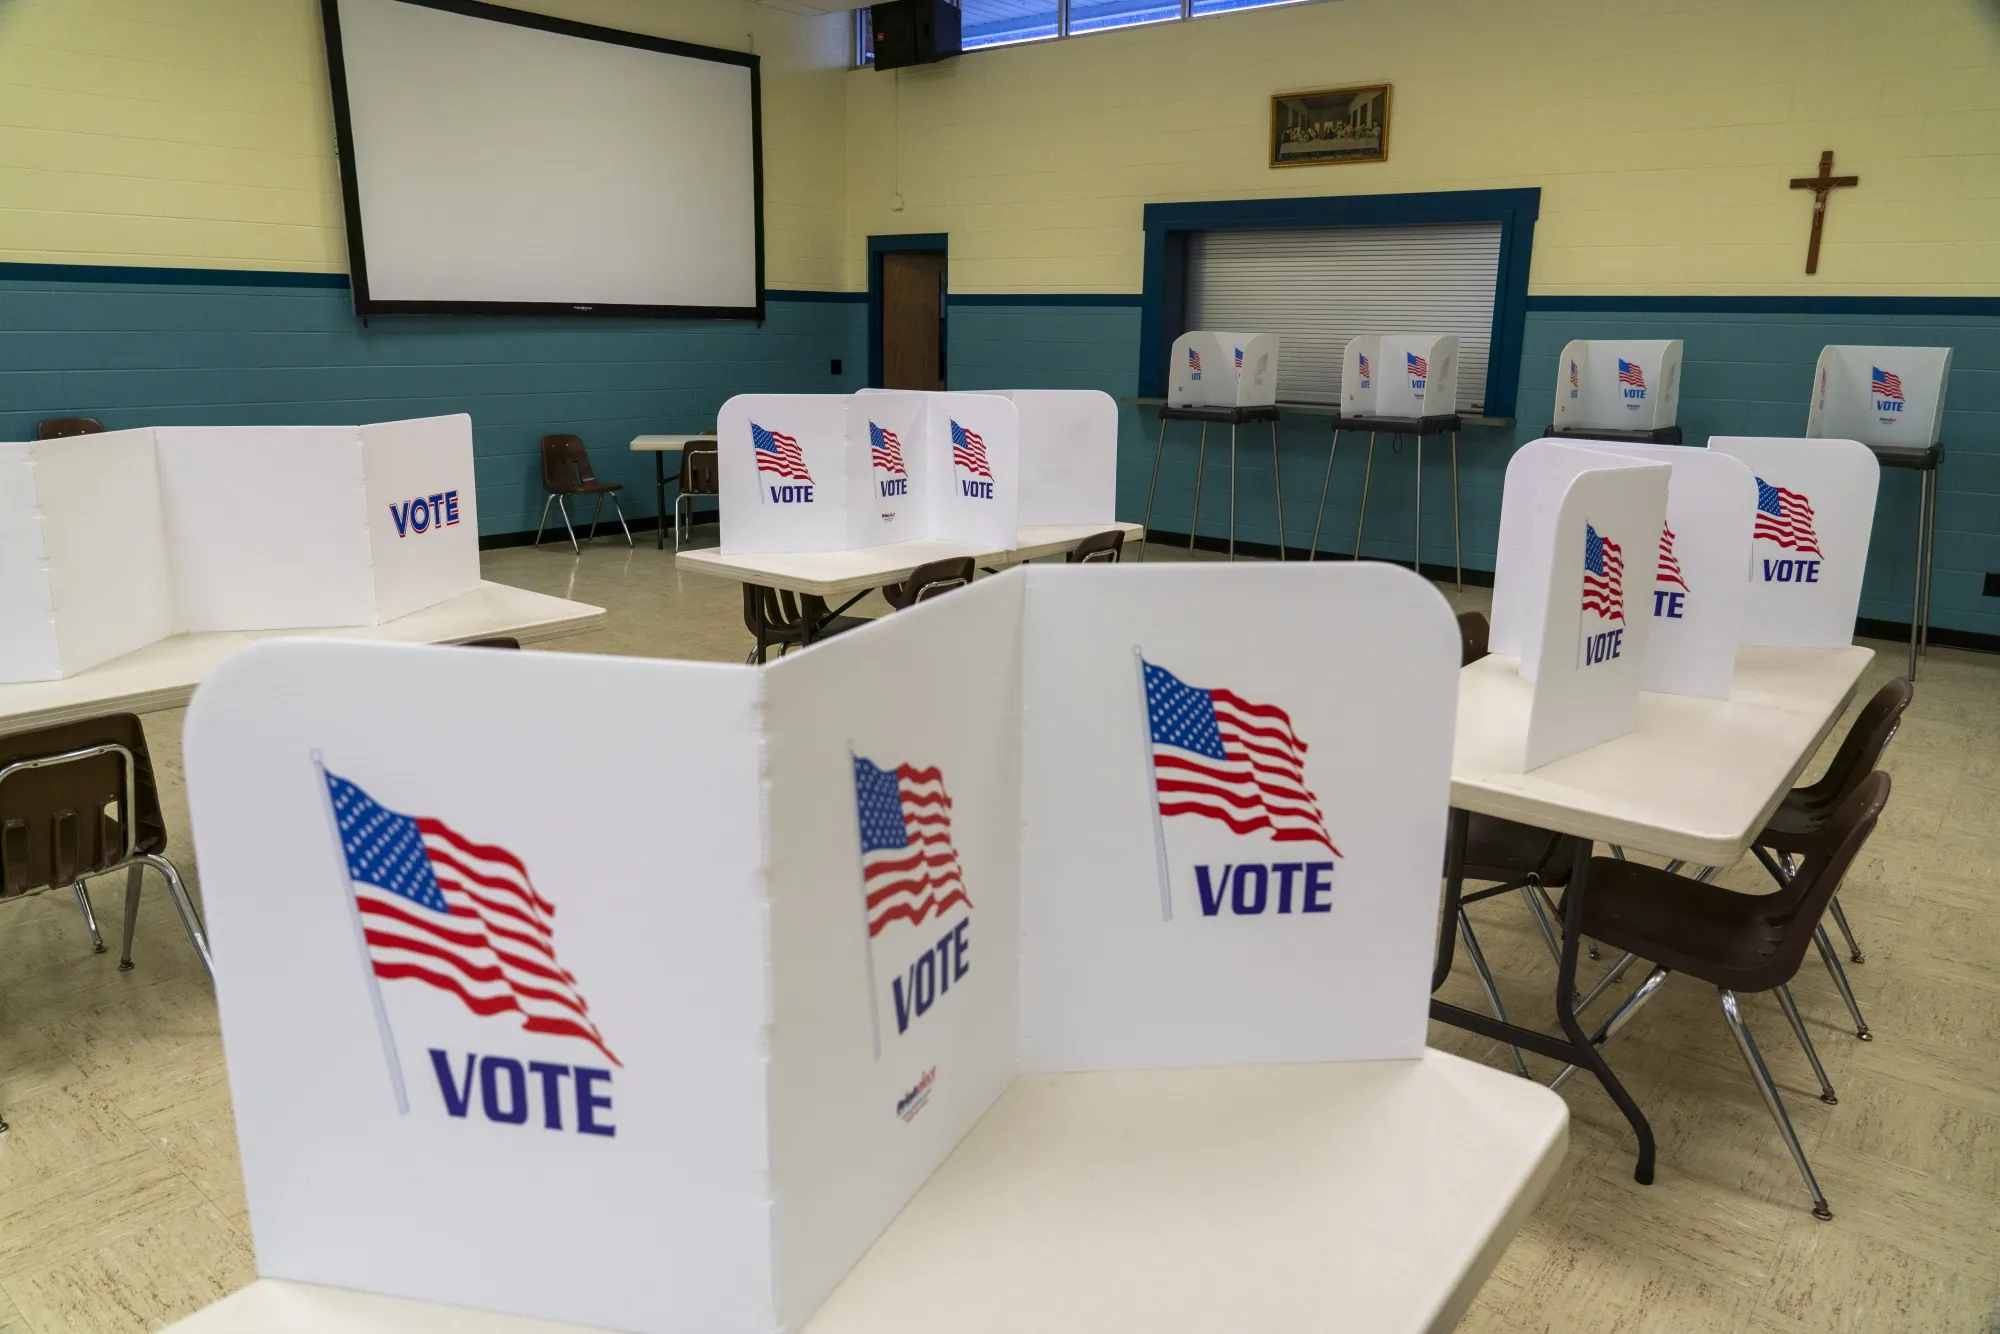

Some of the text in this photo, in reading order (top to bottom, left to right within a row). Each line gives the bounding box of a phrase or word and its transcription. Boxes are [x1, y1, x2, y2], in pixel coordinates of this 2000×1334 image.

[1412, 380, 1426, 389] VOT
[1624, 389, 1646, 399] VOTE
[1877, 400, 1904, 412] VOTE
[770, 485, 814, 504] VOTE
[880, 478, 908, 498] VOTE
[961, 479, 994, 499] VOTE
[389, 490, 460, 538] VOTE
[1762, 559, 1821, 583] VOTE
[1653, 590, 1685, 619] TE
[1586, 628, 1623, 666] VOTE
[1193, 861, 1335, 917] VOTE
[891, 916, 970, 1036] VOTE
[428, 1048, 616, 1138] VOTE
